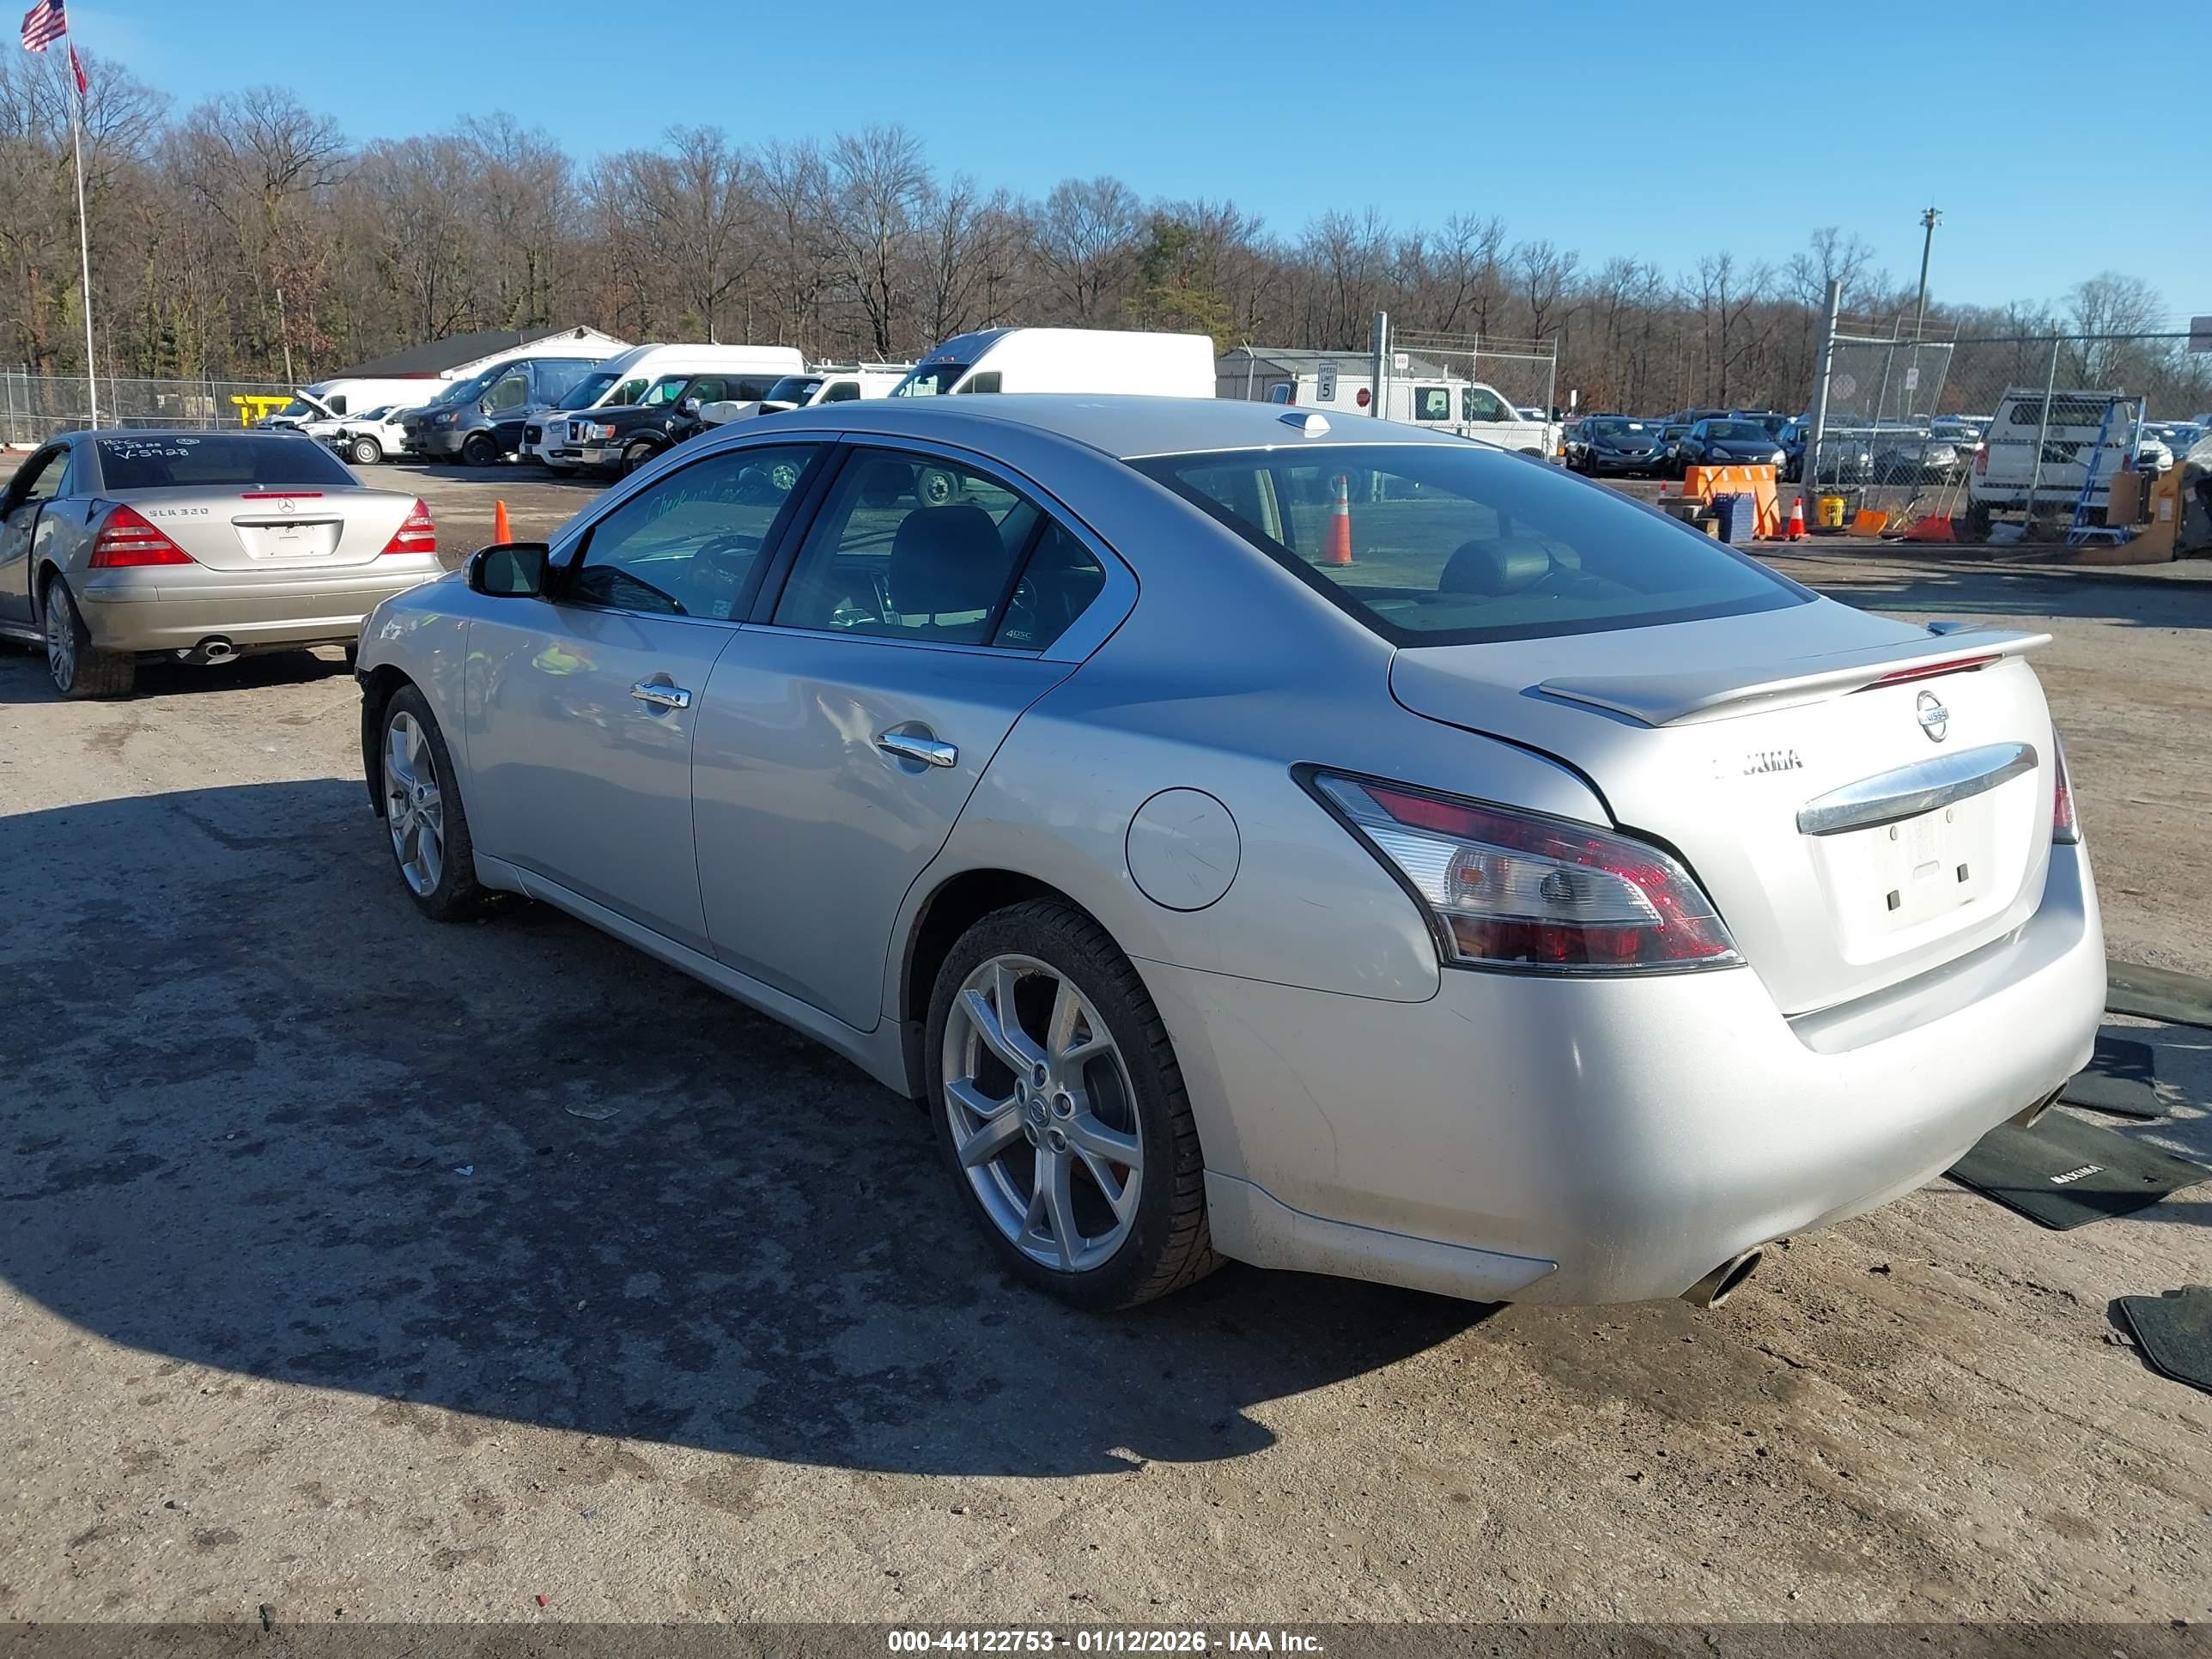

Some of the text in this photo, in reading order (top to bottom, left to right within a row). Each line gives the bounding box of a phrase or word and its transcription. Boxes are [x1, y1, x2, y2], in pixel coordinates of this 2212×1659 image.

[1322, 383, 1330, 397] 5
[1712, 749, 1803, 780] XIMA
[2050, 1164, 2105, 1184] MAXIMA
